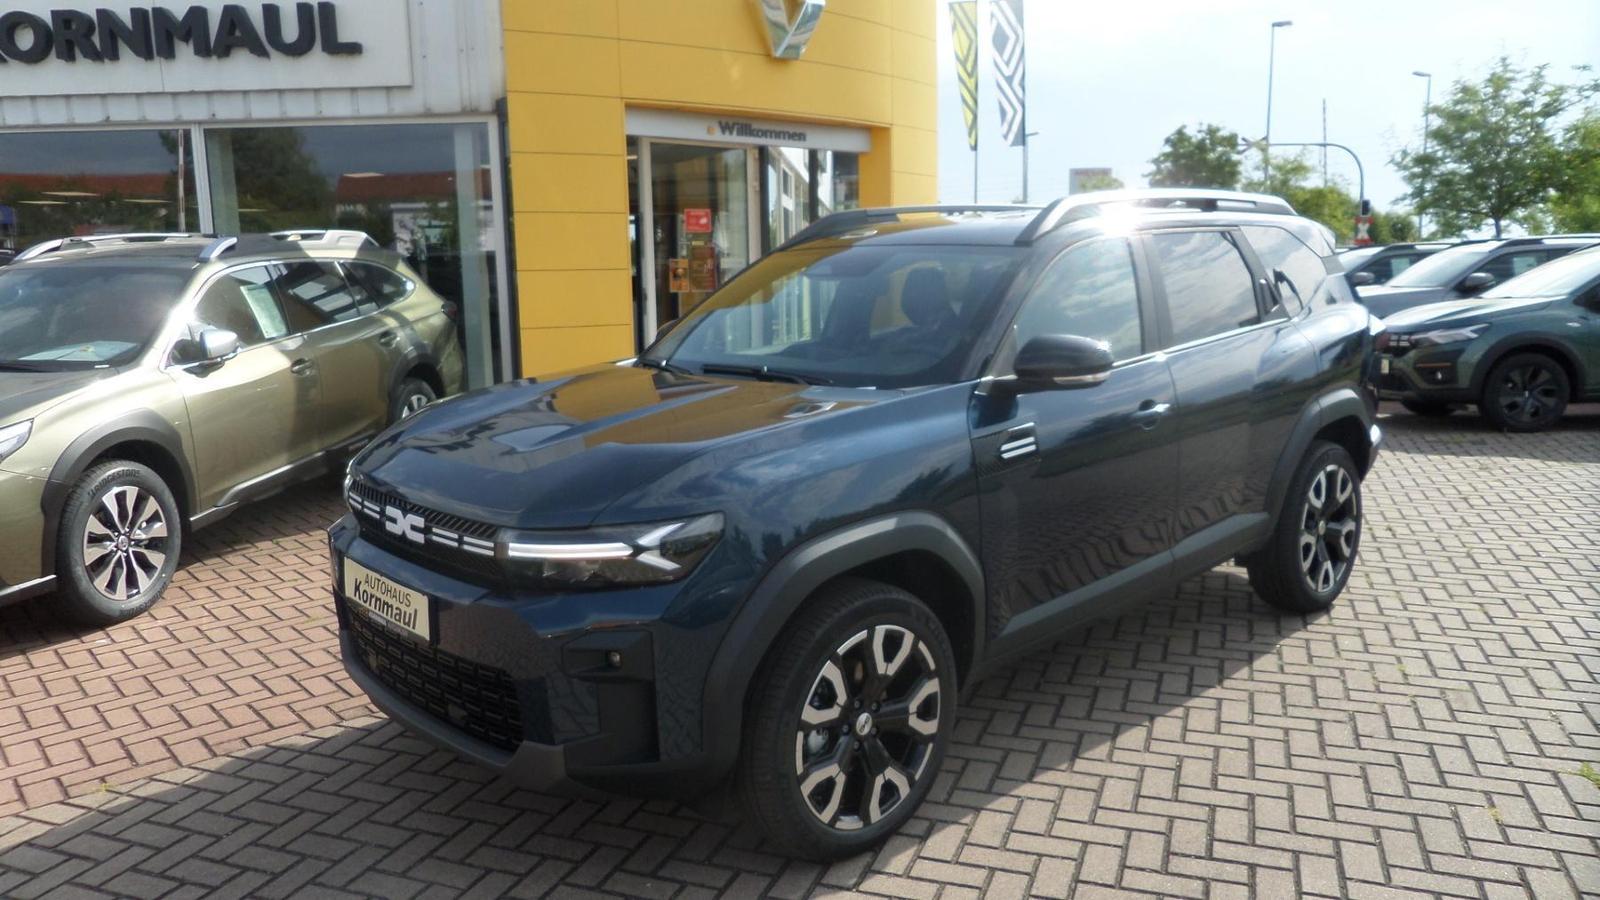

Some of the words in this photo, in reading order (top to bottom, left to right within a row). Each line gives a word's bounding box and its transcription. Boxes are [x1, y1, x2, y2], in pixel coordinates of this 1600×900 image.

[0, 1, 363, 64] ORNMAUL
[718, 120, 807, 141] Willkommen
[353, 577, 418, 630] Kornmaul
[364, 574, 412, 608] AUTOHAUS
